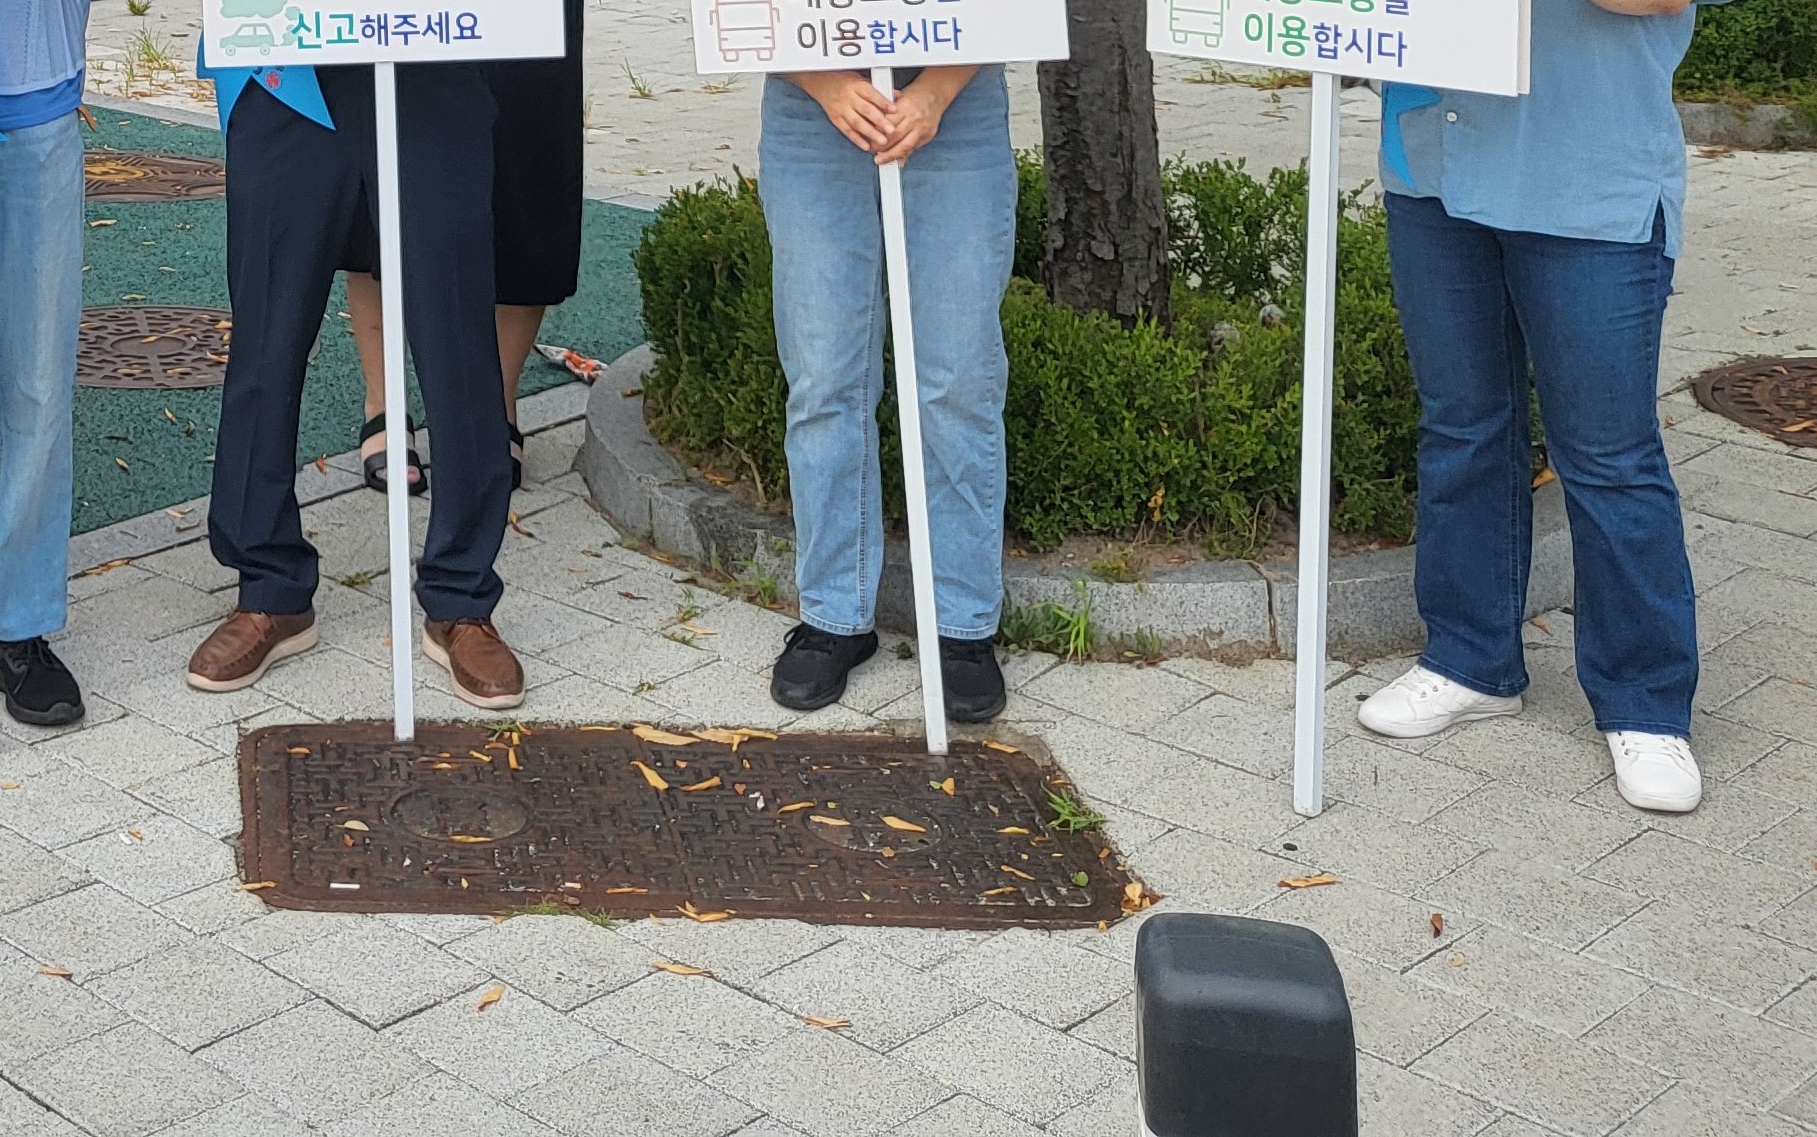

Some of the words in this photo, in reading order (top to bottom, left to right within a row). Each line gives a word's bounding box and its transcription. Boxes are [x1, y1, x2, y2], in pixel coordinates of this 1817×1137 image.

[290, 11, 483, 50] 신고해주세요
[797, 16, 963, 57] 이용합시다
[1244, 12, 1408, 68] 이용합시다
